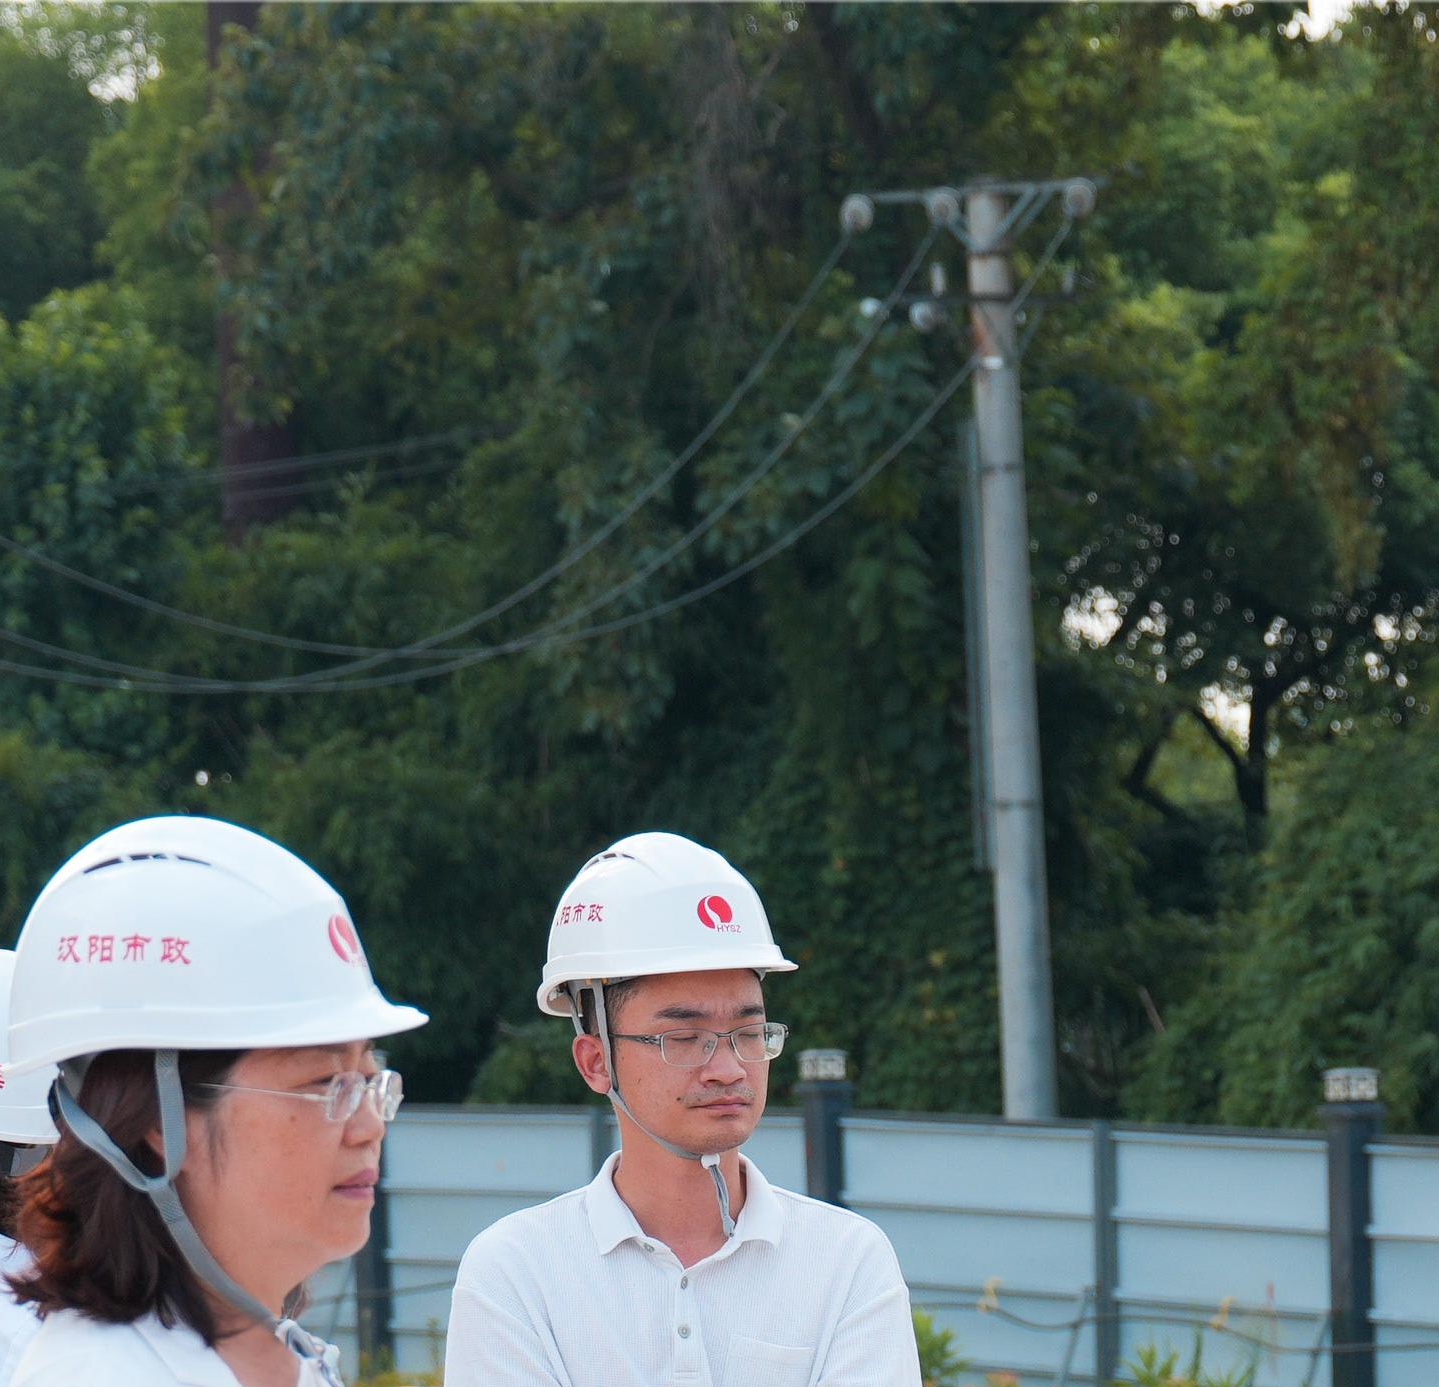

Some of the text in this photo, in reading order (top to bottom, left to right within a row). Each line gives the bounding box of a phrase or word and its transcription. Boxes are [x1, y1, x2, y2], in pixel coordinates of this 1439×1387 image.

[555, 903, 604, 926] 阳市政
[717, 924, 742, 933] HYSZ
[57, 933, 191, 965] 汉阳市政
